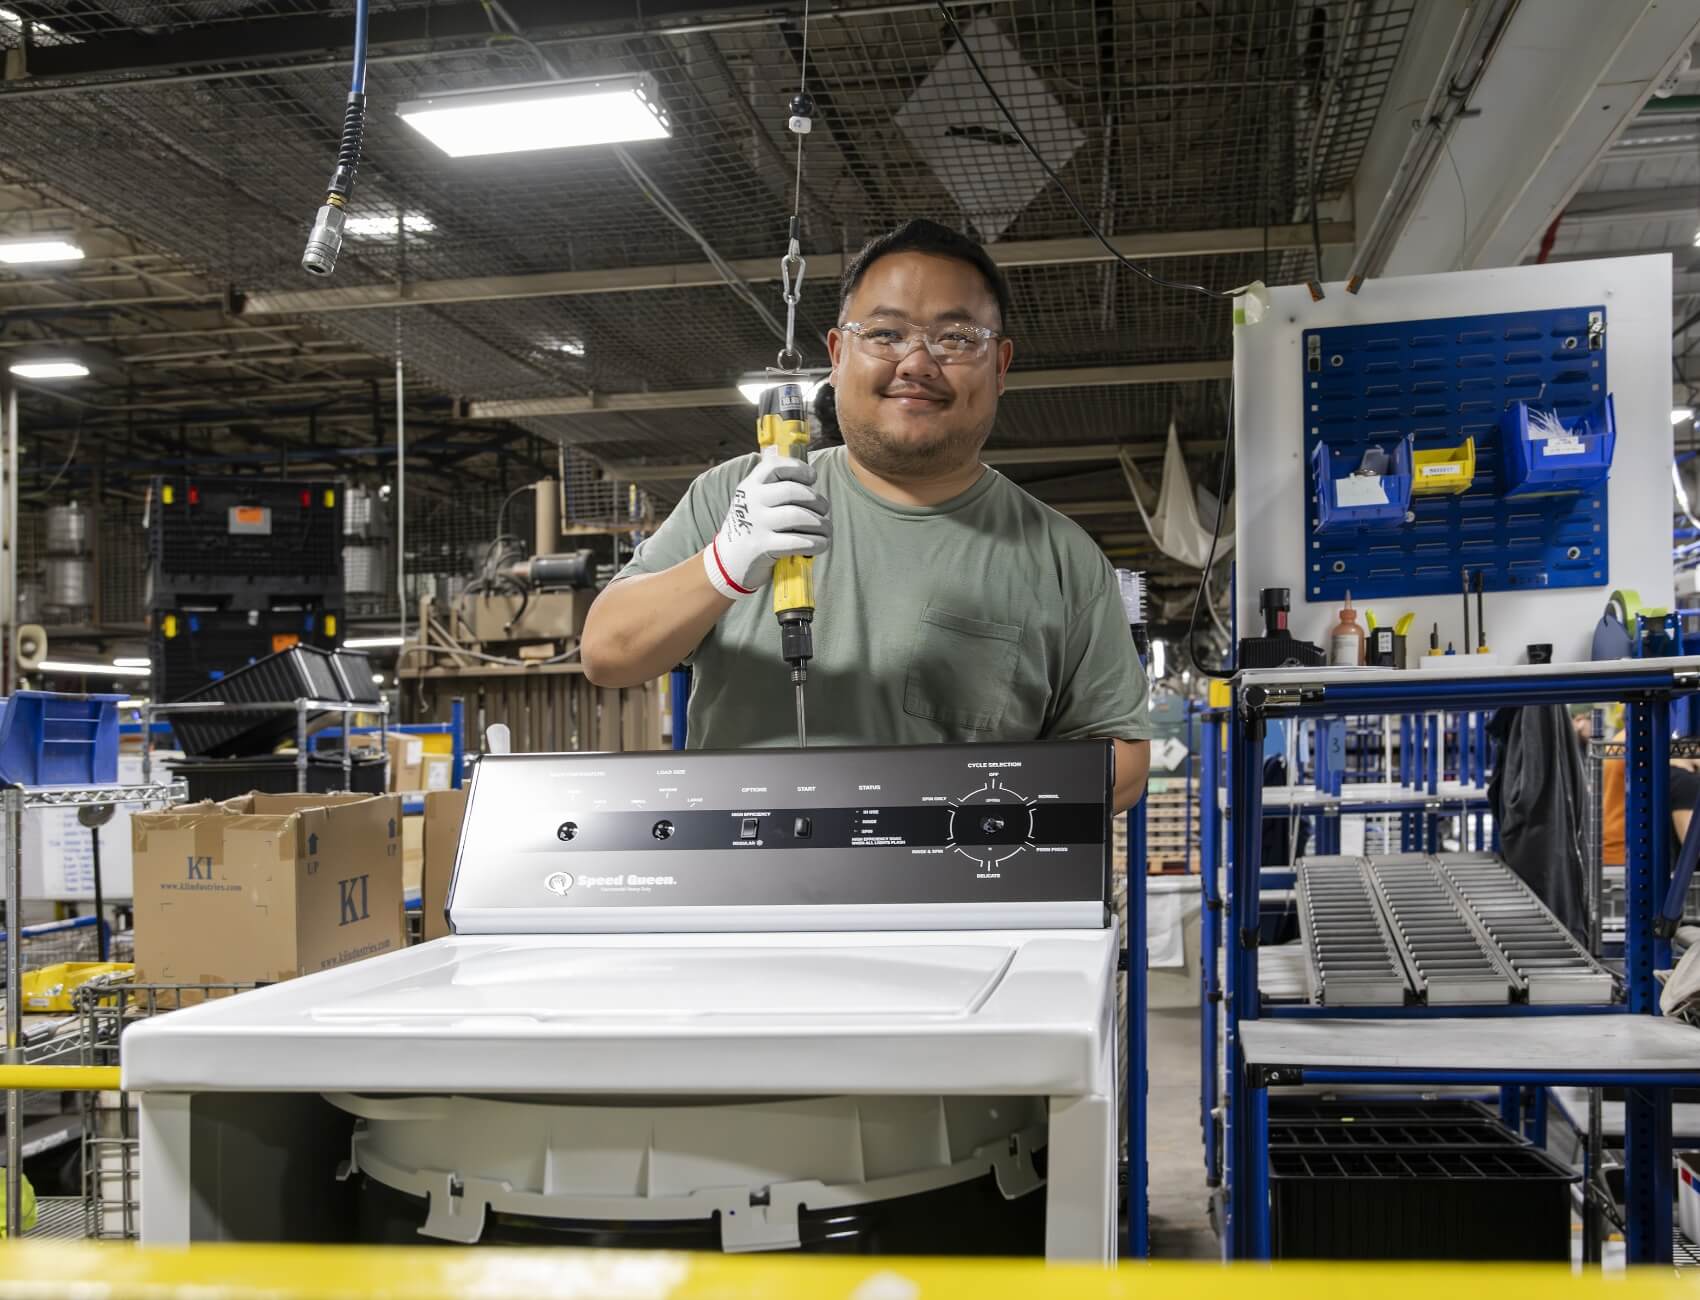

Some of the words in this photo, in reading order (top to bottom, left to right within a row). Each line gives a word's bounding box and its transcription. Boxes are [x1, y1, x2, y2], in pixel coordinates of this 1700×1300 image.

[1332, 737, 1341, 754] 3
[187, 855, 213, 880] KI
[577, 874, 624, 888] Speed
[338, 874, 370, 926] KI
